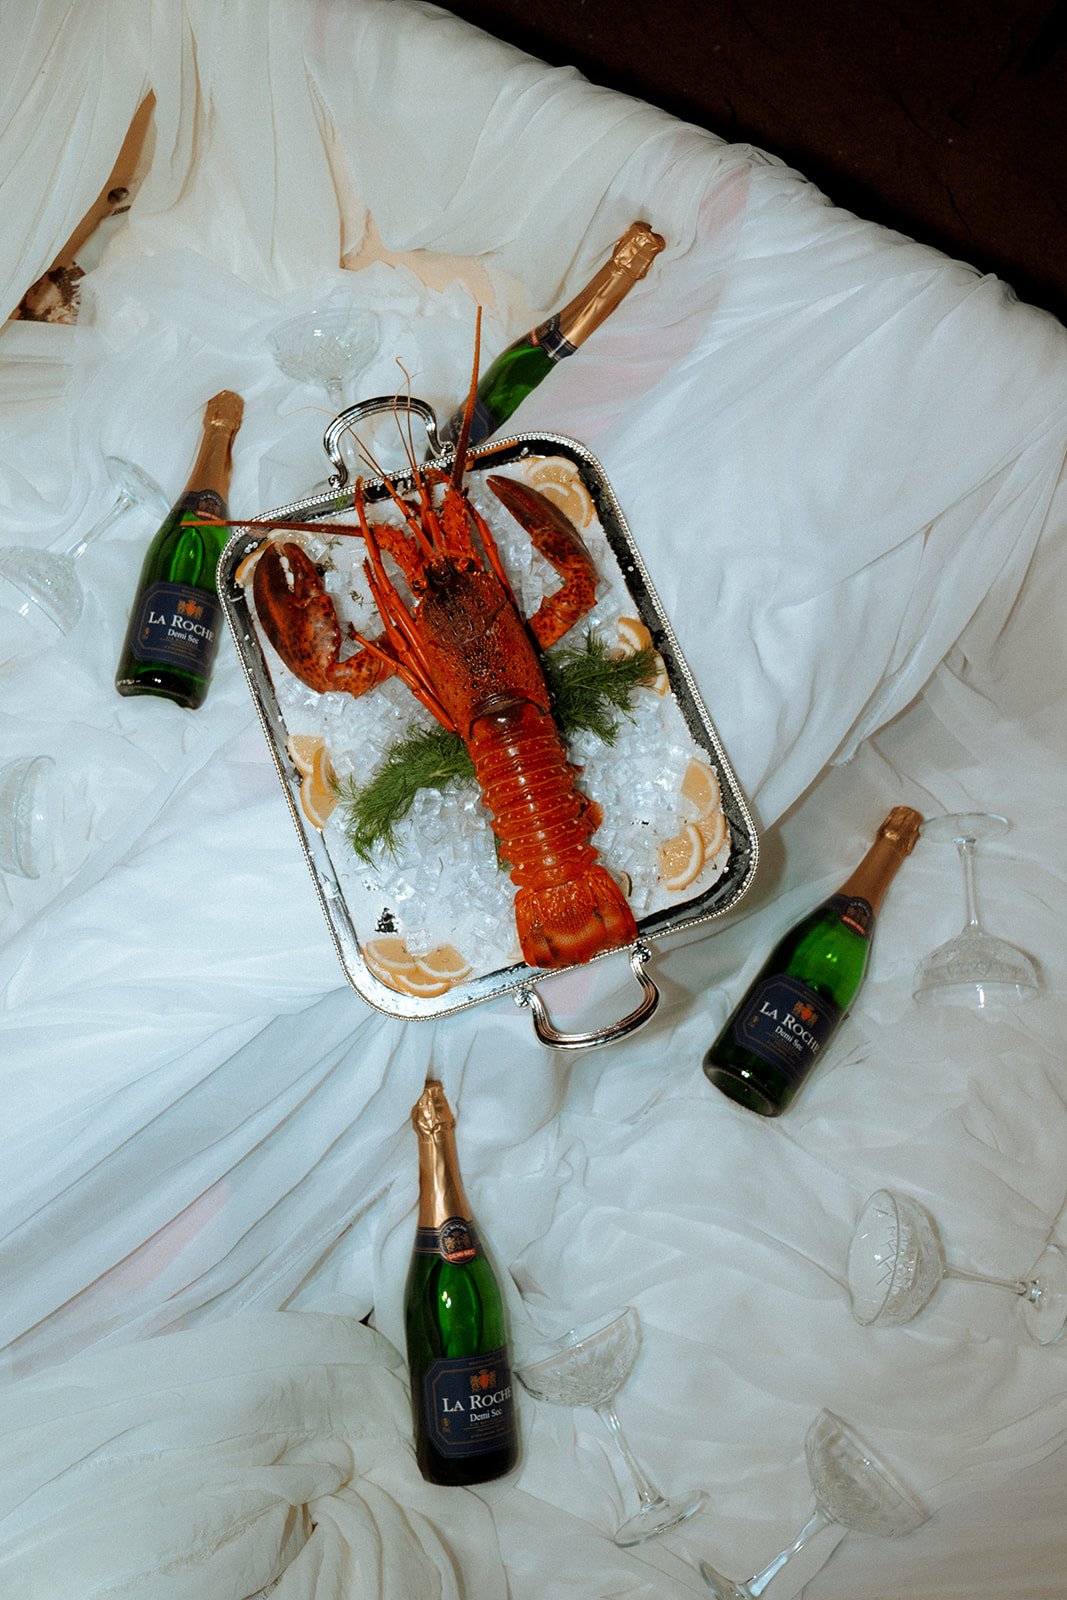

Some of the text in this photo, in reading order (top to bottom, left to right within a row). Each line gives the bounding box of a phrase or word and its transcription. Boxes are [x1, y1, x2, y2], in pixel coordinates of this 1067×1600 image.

[148, 611, 215, 642] LA ROCHE
[167, 629, 200, 645] Demi Sec
[760, 1001, 778, 1020] LA
[781, 1013, 820, 1054] ROCHE
[774, 1026, 795, 1042] Demi
[792, 1039, 804, 1052] Sec
[442, 1386, 512, 1412] LA ROCHE
[470, 1408, 502, 1422] Demi Sec
